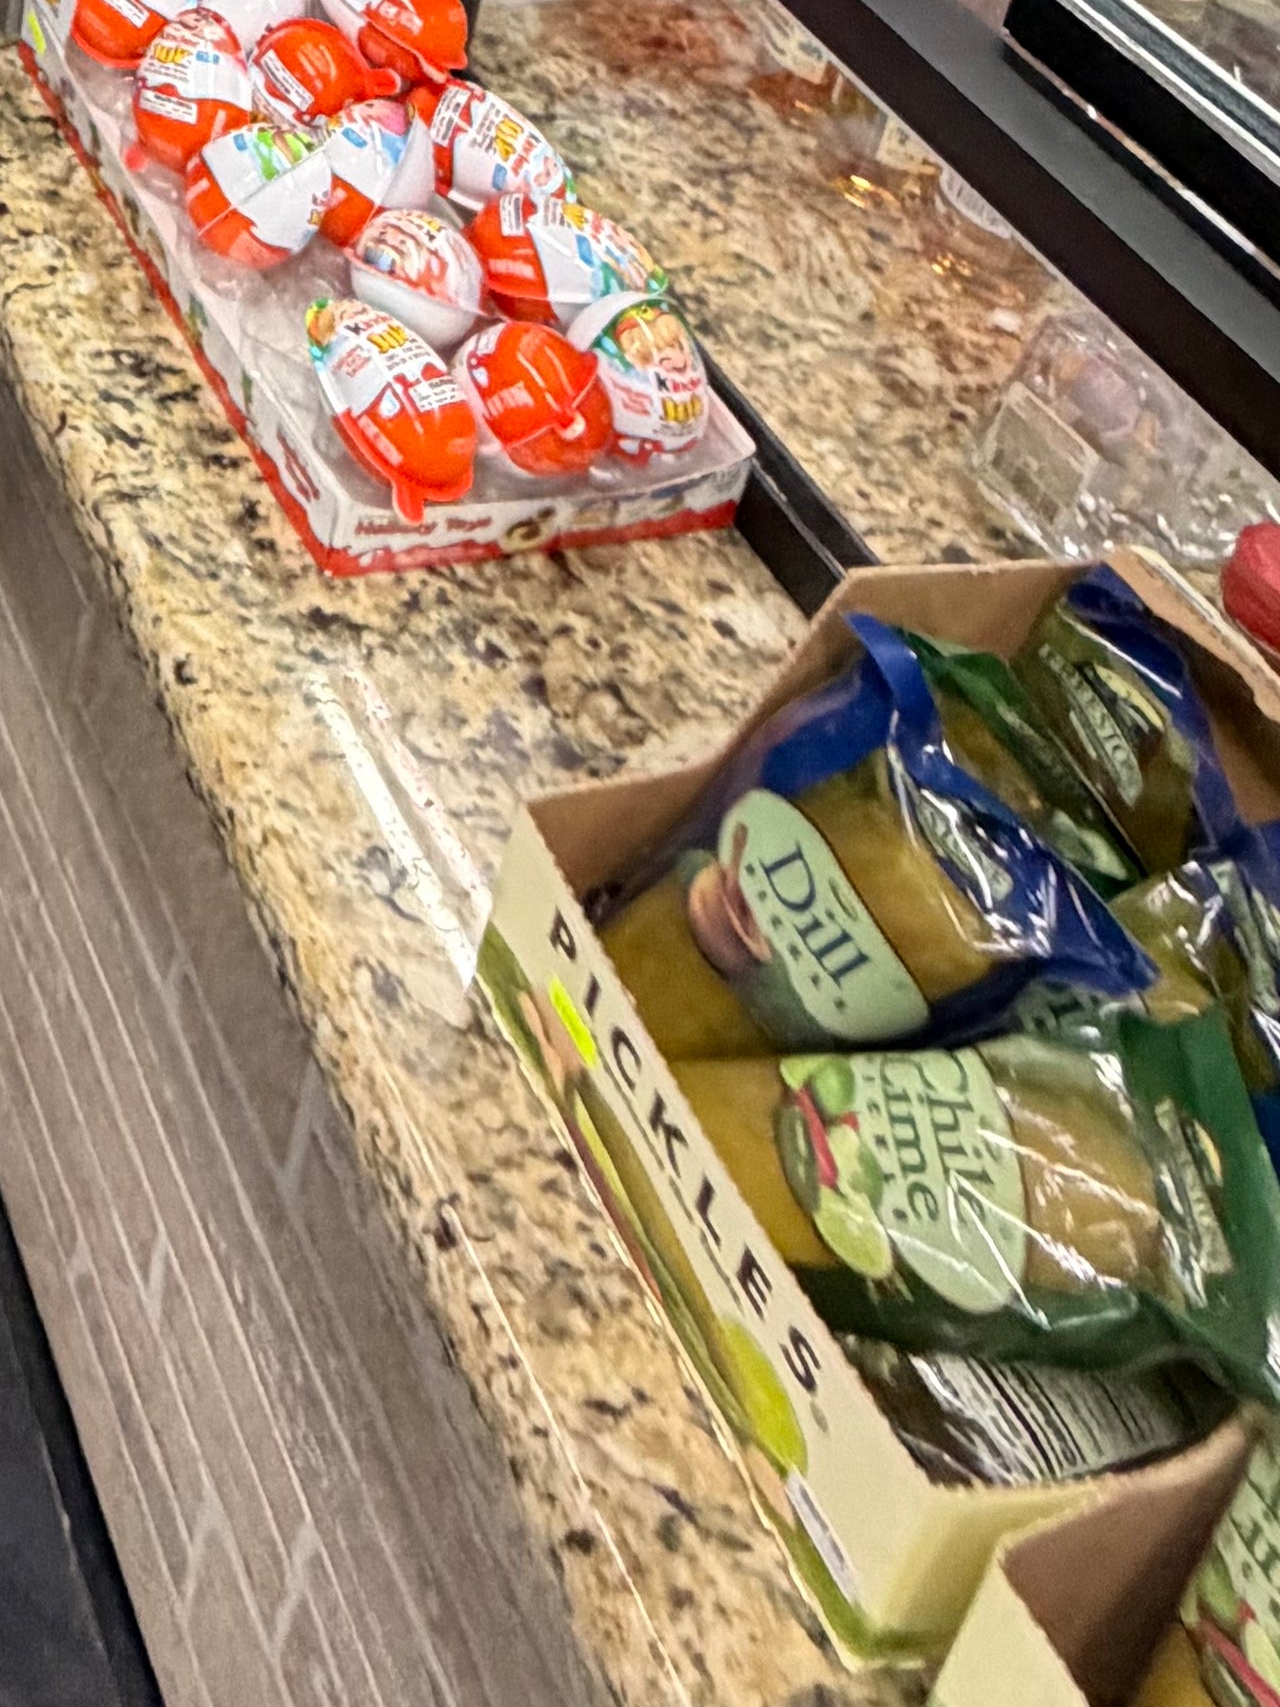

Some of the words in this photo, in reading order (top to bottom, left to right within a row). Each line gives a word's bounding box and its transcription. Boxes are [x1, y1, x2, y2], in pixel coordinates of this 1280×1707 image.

[758, 840, 871, 988] Dill
[549, 906, 823, 1395] PICKLES
[917, 1052, 997, 1228] Chile
